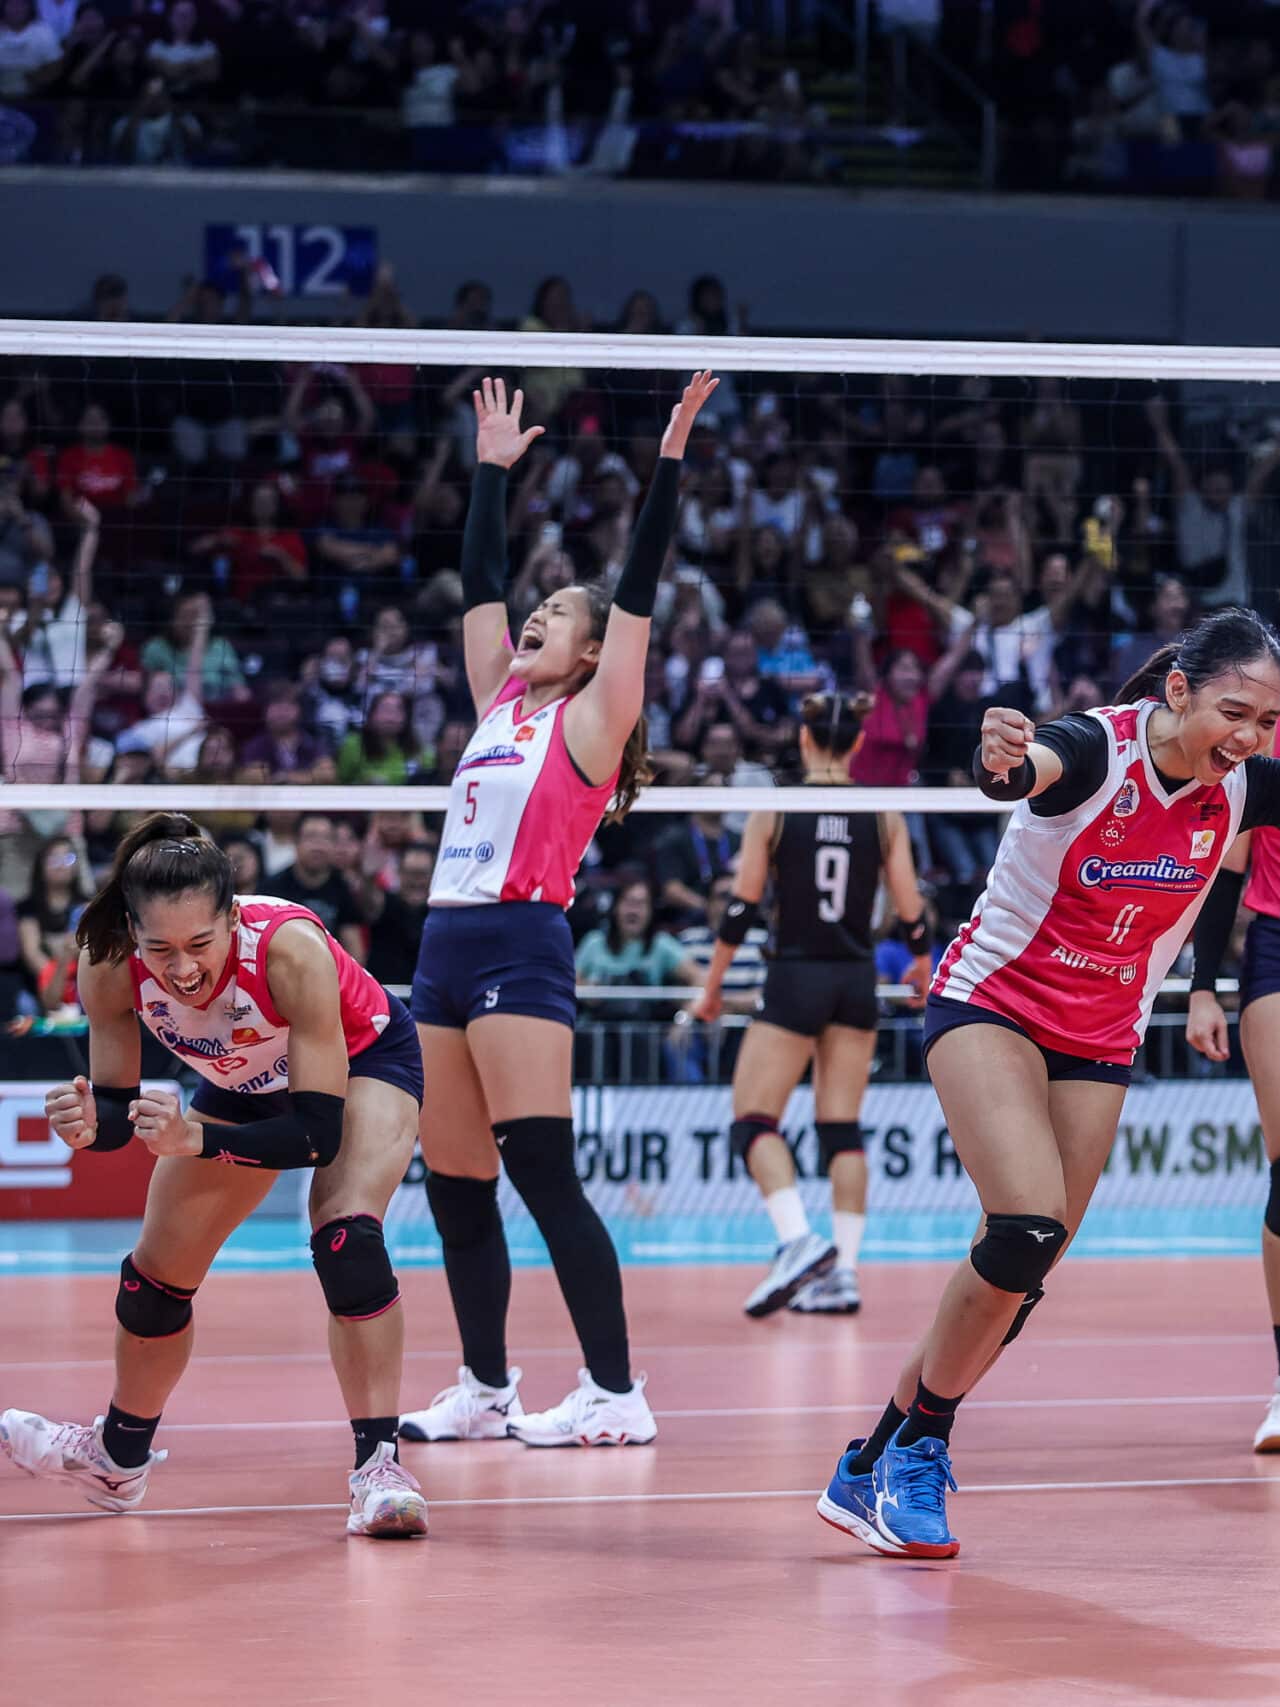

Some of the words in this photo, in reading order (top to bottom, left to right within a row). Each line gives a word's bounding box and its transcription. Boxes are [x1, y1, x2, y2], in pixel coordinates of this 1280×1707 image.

[235, 225, 349, 294] 112
[464, 781, 480, 825] 5
[814, 846, 850, 923] 9
[1080, 857, 1196, 887] Creamline
[1106, 903, 1144, 945] 11
